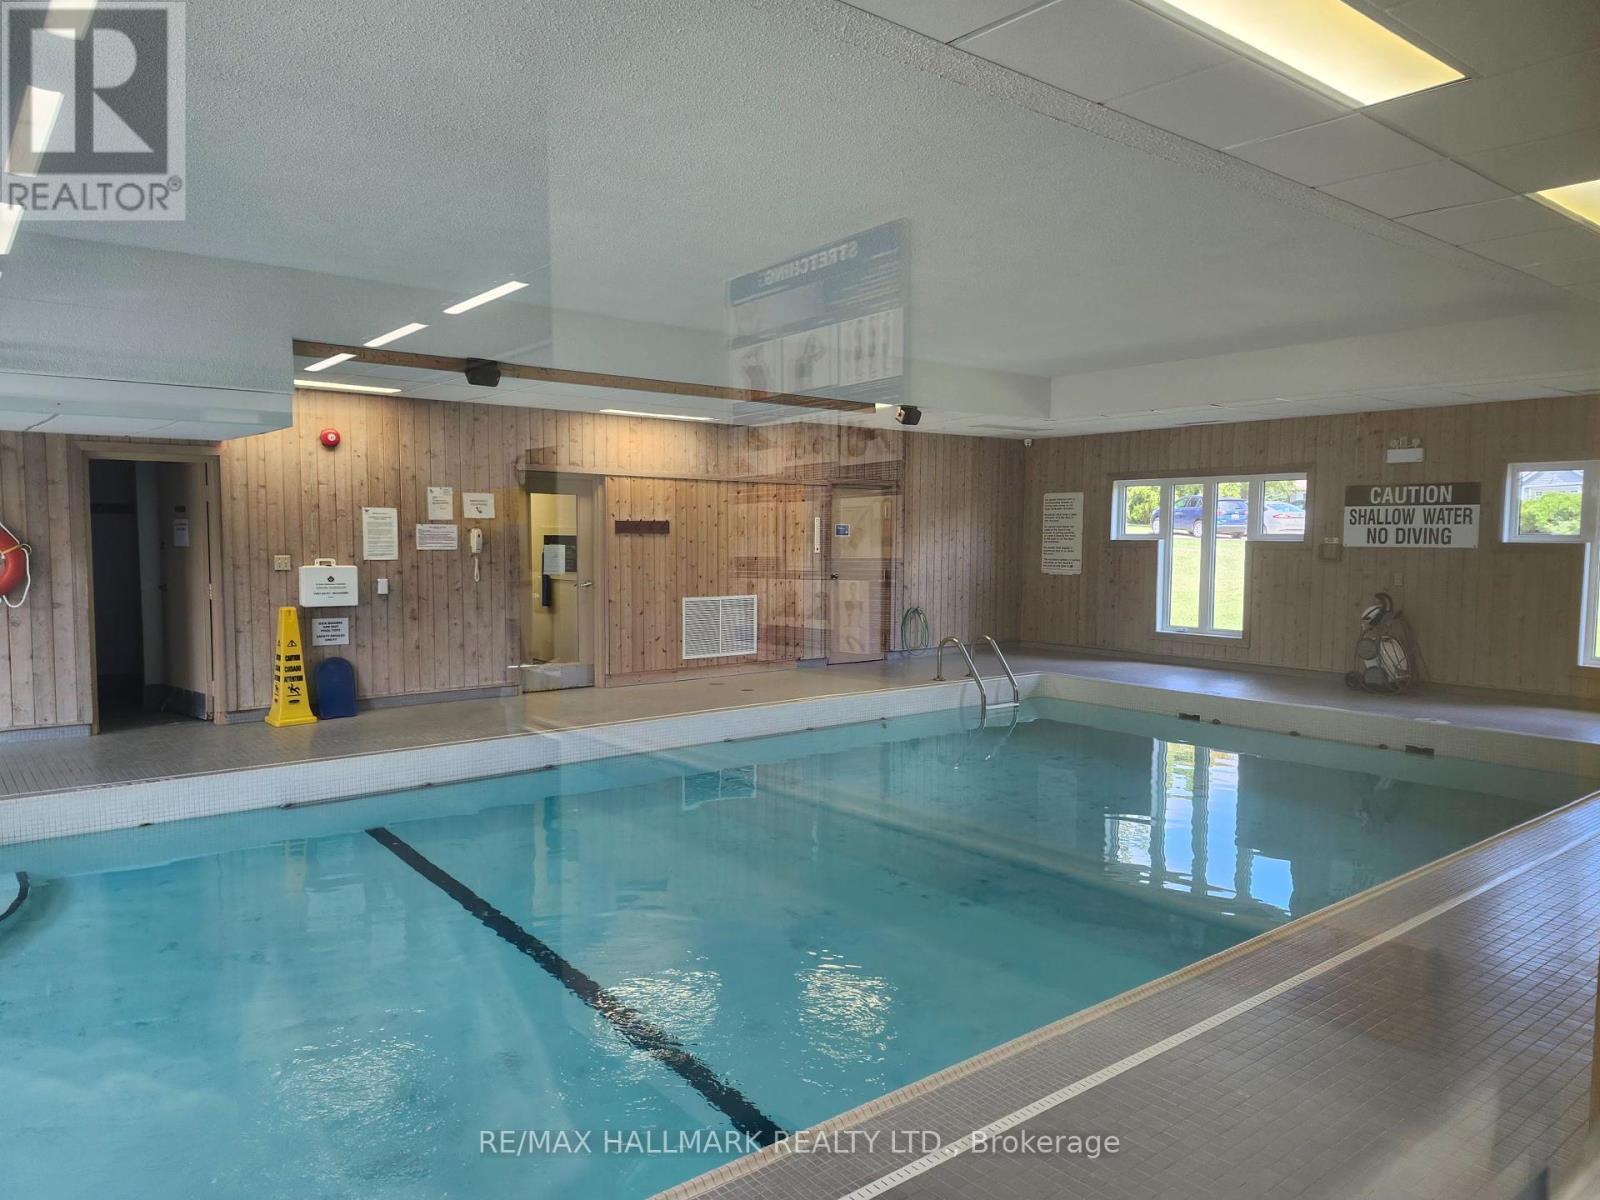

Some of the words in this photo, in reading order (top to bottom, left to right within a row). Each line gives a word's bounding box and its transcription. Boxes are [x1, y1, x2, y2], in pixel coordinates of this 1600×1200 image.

[1370, 485, 1453, 505] CAUTION
[1349, 508, 1416, 526] SHALLOW
[1423, 507, 1473, 525] WATER
[1366, 527, 1389, 545] NO
[1395, 527, 1453, 545] DIVING
